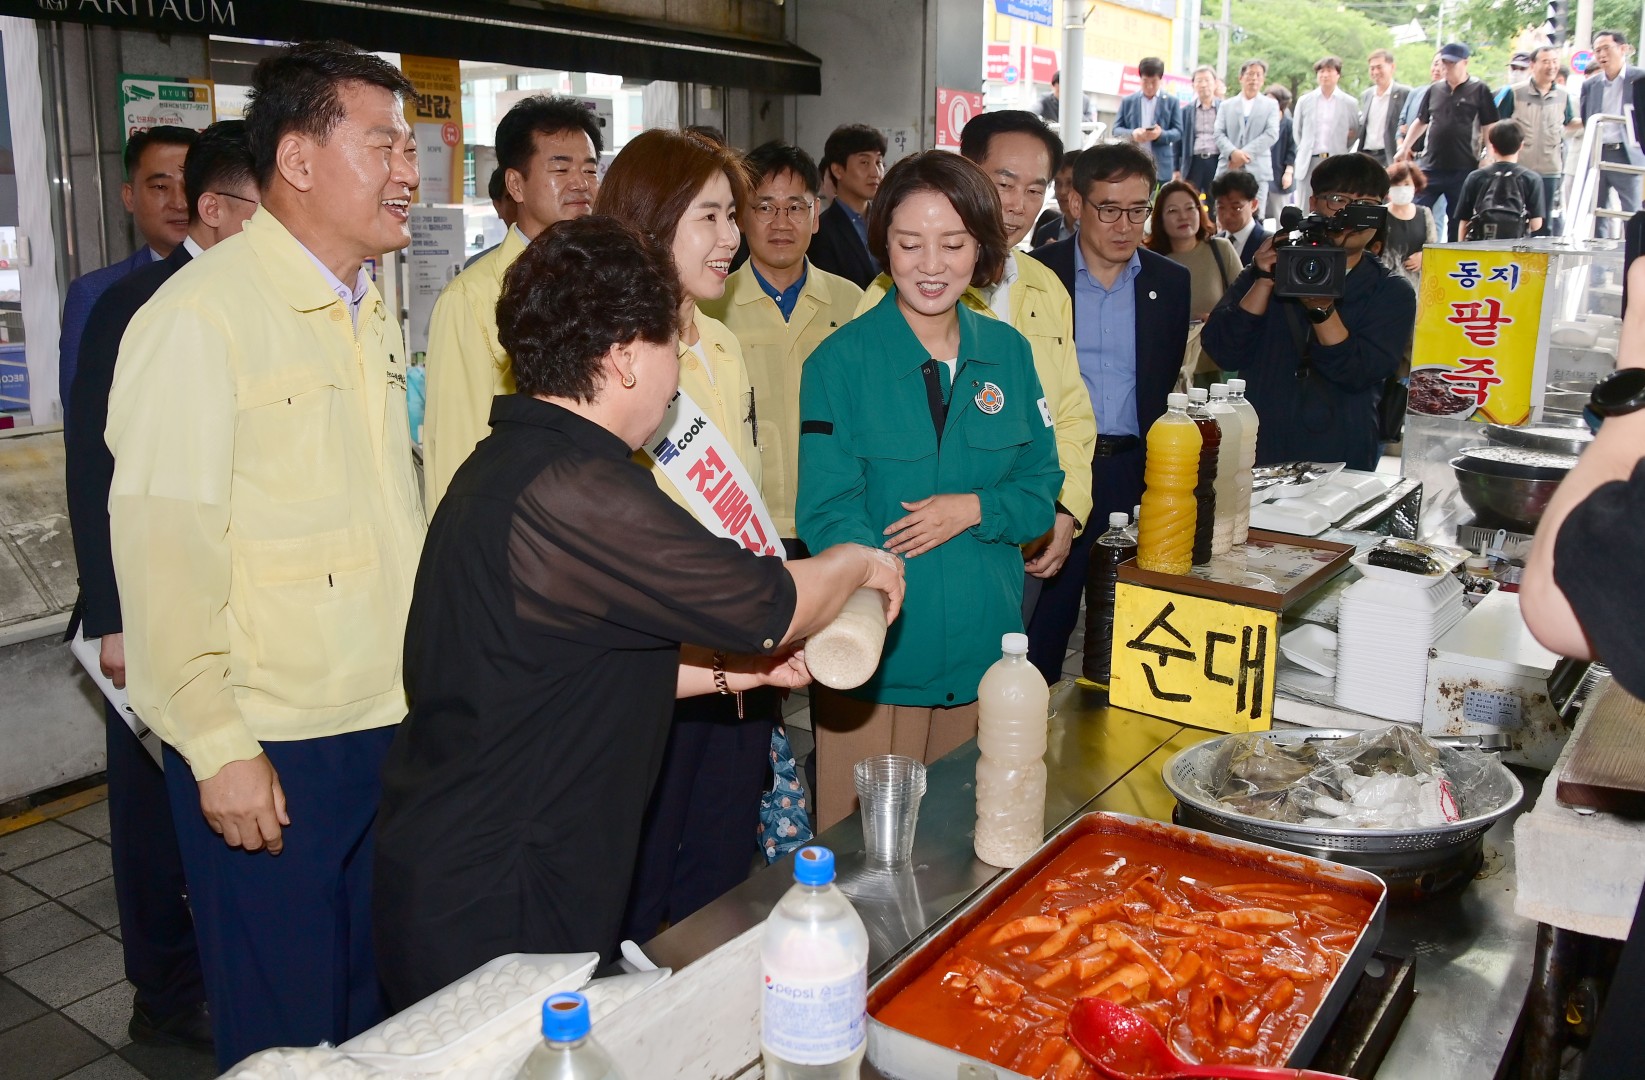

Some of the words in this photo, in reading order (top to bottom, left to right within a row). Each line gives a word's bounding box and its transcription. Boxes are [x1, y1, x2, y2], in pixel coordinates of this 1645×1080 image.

[161, 90, 206, 98] HYUNDAI
[416, 93, 452, 119] 반값
[1449, 261, 1520, 291] 동지
[677, 415, 708, 451] cook
[685, 445, 776, 556] 전통시
[1125, 601, 1268, 720] 순대
[775, 983, 814, 999] pepsi
